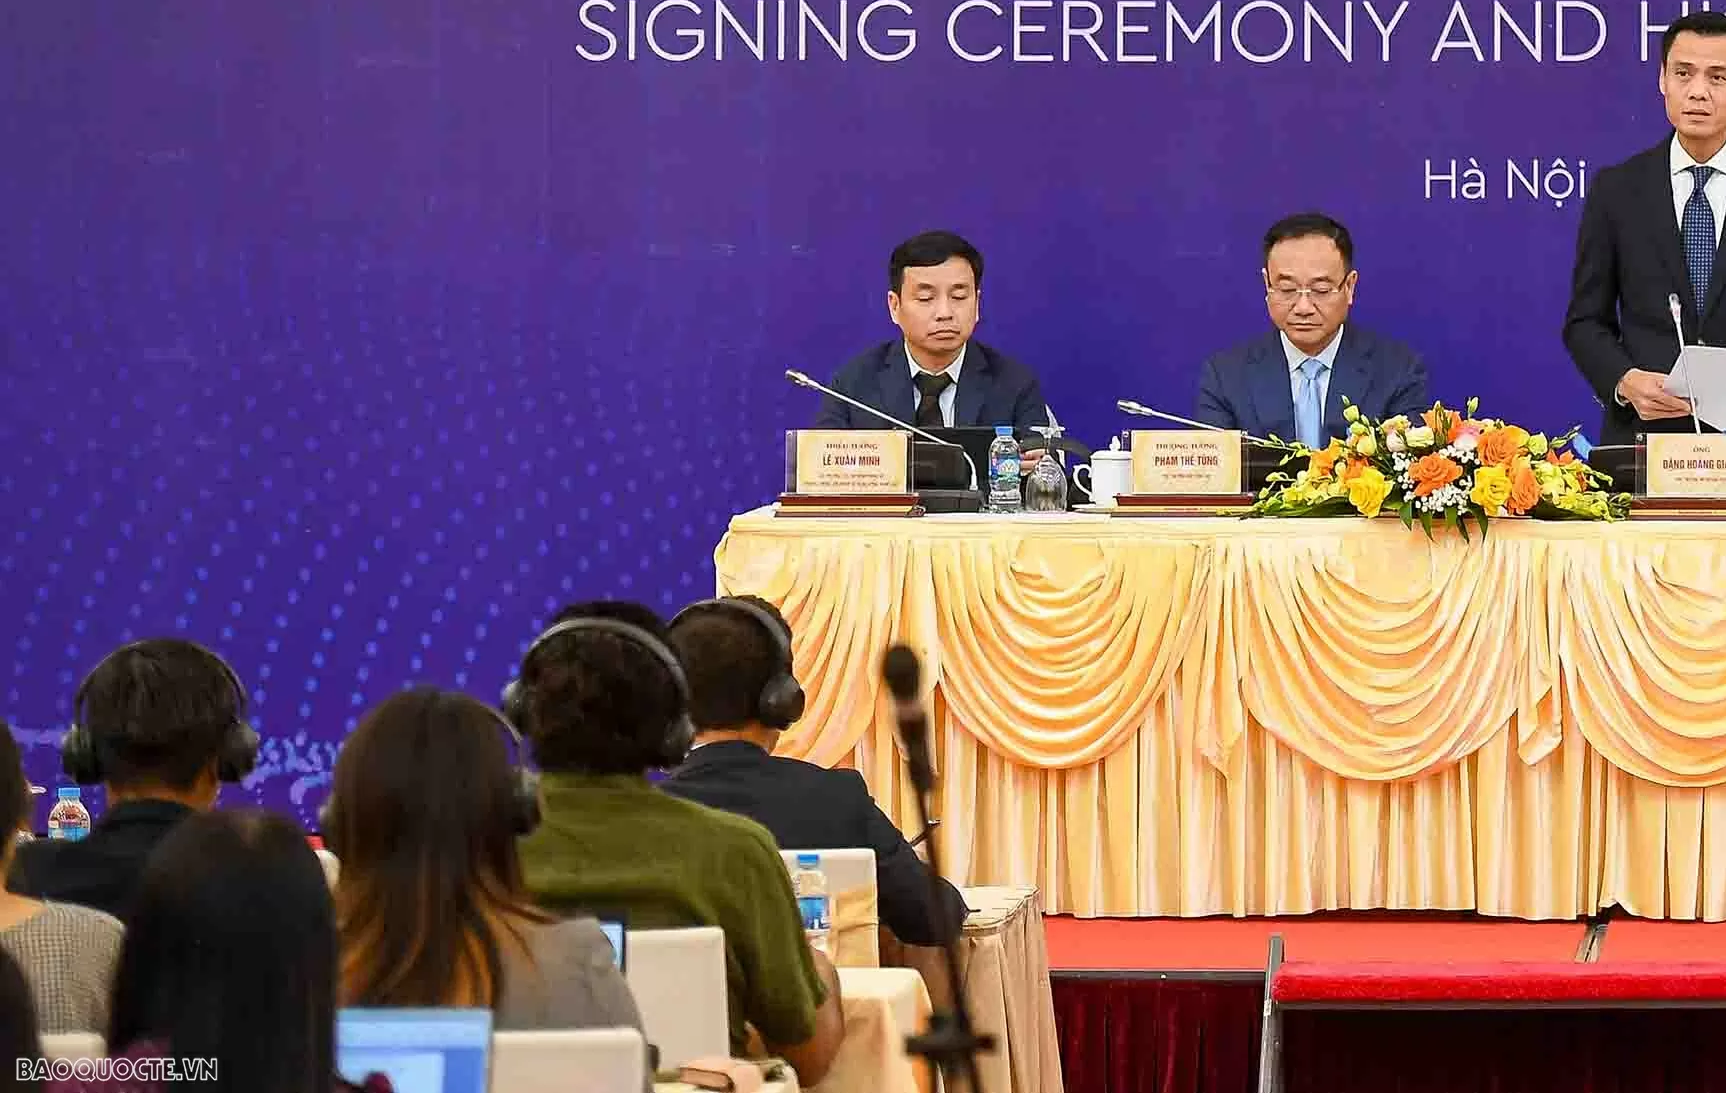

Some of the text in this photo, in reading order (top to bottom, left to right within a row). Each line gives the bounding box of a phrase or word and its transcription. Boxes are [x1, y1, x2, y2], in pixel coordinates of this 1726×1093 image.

[1431, 0, 1607, 64] AND
[1424, 157, 1486, 200] Hà
[1506, 158, 1586, 208] Nội
[859, 455, 880, 466] MINH
